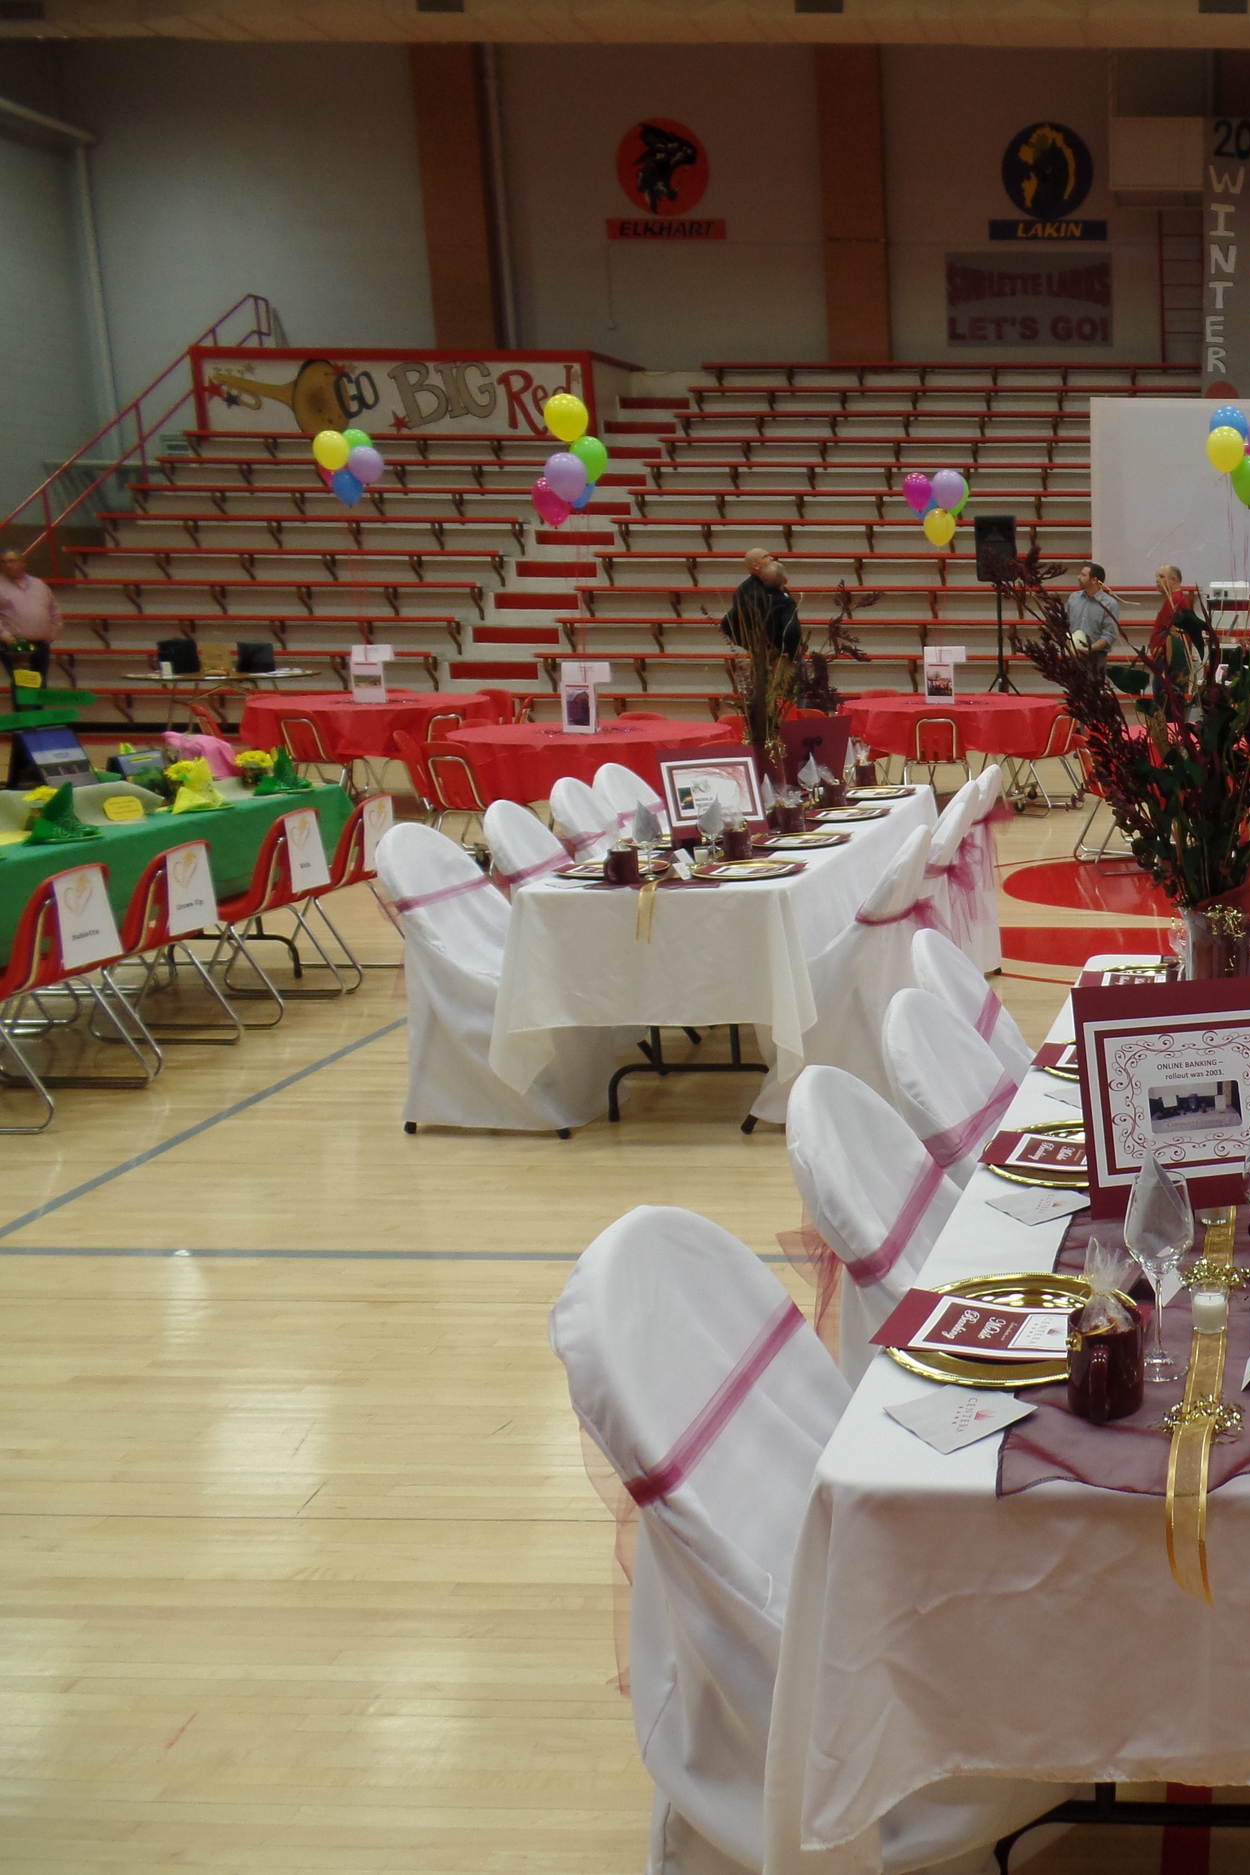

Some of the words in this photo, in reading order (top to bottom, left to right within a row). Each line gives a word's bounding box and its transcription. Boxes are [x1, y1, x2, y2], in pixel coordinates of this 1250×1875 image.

[619, 221, 714, 237] ELKHART
[1016, 222, 1083, 238] LAKIN
[1205, 165, 1245, 373] WINTER
[948, 315, 1039, 341] LET'S
[1050, 315, 1109, 341] GO!
[333, 370, 380, 419] GO
[388, 359, 498, 430] BIG
[1157, 1062, 1183, 1070] ONLINE
[1185, 1059, 1217, 1068] BANKING
[1165, 1072, 1189, 1080] rollout
[1205, 1068, 1225, 1077] 2003.
[942, 1309, 980, 1340] Banking
[977, 1316, 1006, 1340] Mobile
[956, 1397, 978, 1432] CENTERA
